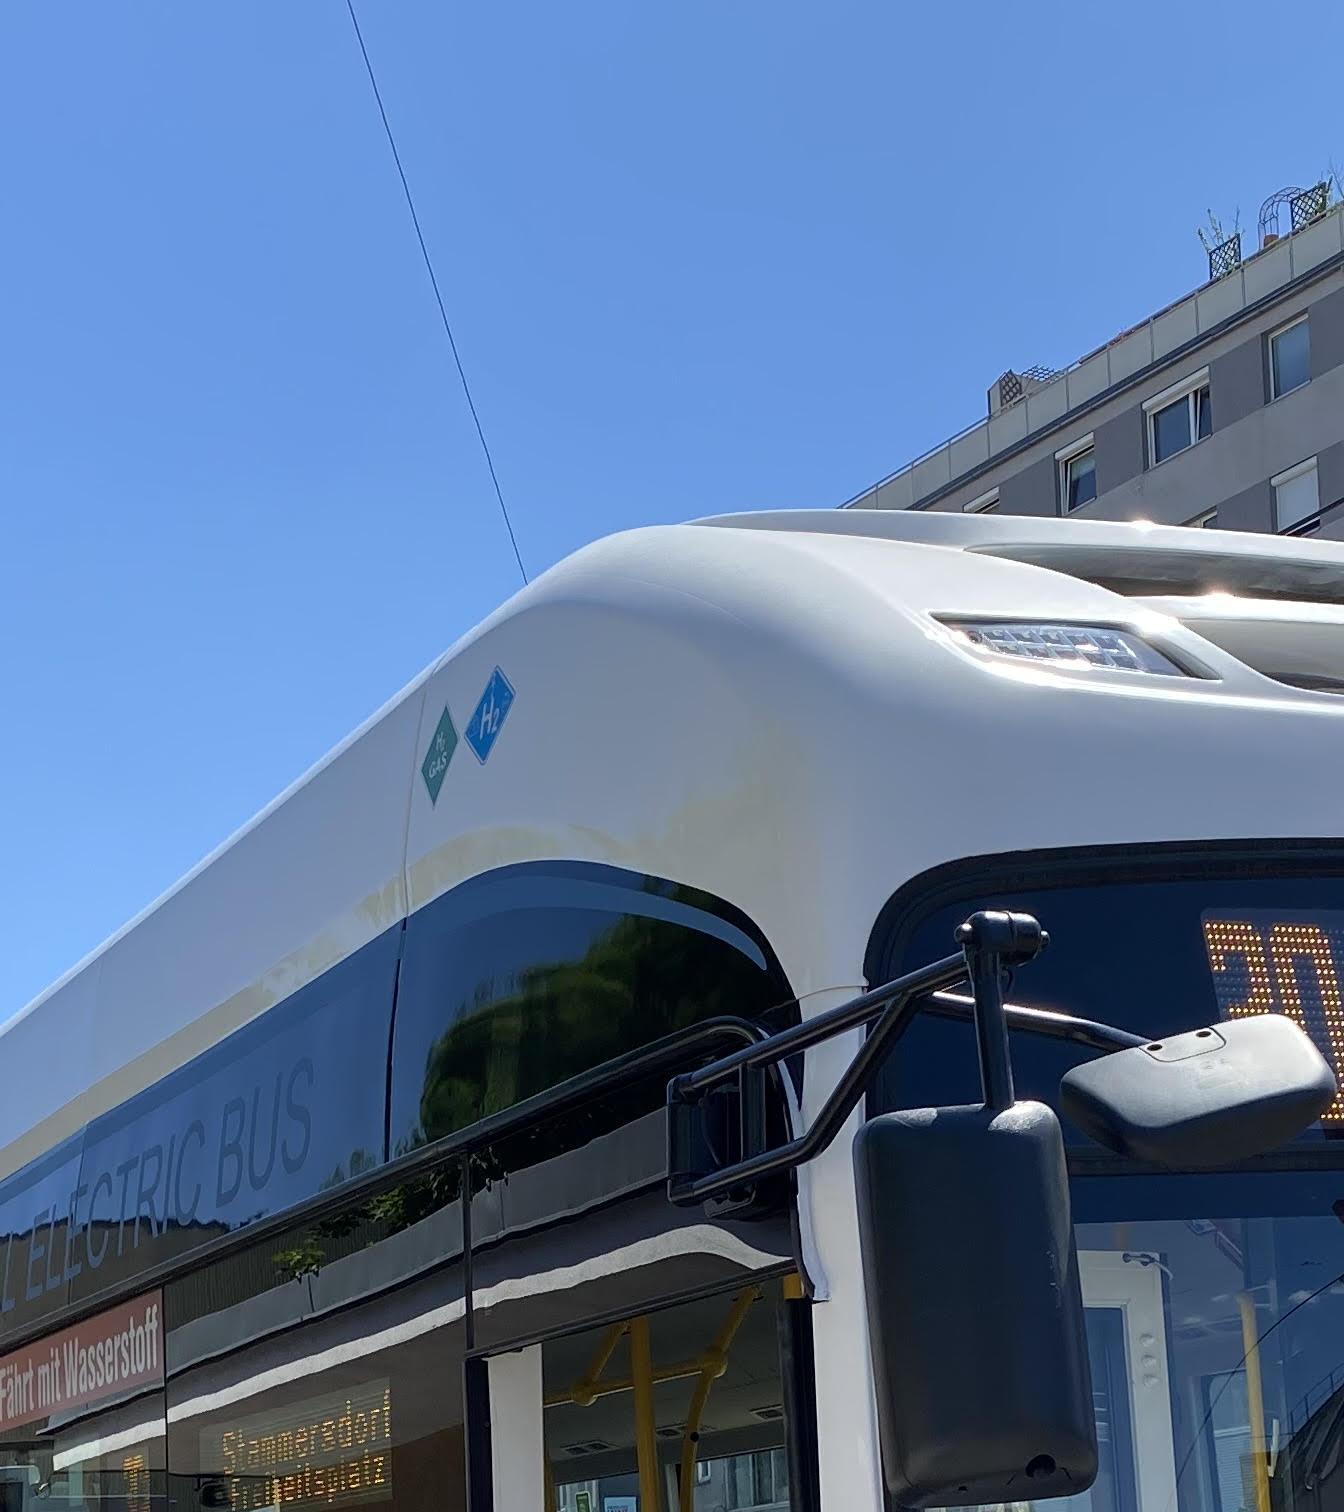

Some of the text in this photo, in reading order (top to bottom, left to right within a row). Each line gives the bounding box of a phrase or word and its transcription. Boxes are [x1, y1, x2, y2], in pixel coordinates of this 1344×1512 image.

[429, 753, 448, 778] GAS
[26, 1119, 205, 1301] ELECTRIC
[216, 1056, 314, 1208] BUS
[0, 1303, 158, 1422] Fährt mit Wasserstoff
